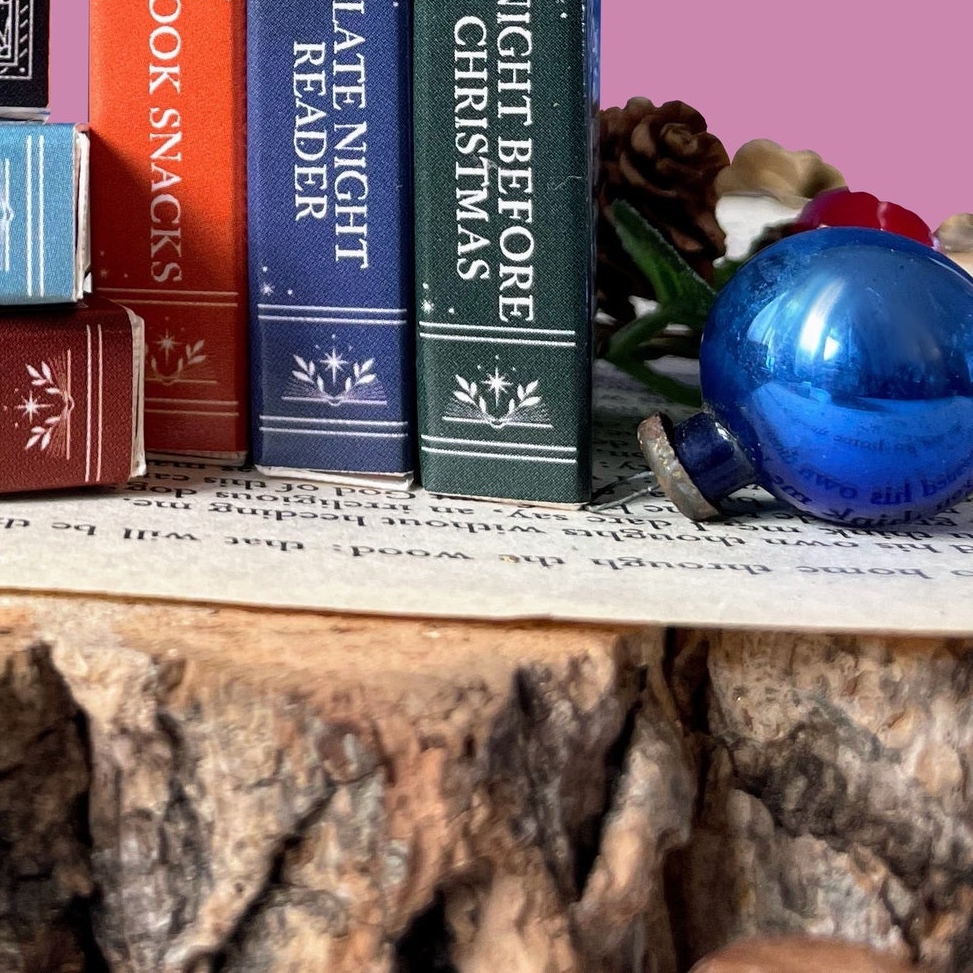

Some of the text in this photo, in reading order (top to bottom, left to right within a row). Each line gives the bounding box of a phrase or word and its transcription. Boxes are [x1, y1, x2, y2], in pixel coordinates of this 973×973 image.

[292, 41, 328, 221] READER
[331, 0, 369, 269] LATE NIGHT
[453, 15, 490, 280] CHRISTMAS
[149, 106, 184, 283] SNACKS
[497, 135, 535, 323] BEFORE
[203, 476, 268, 490] this
[274, 482, 319, 493] of
[215, 492, 412, 514] irreligious
[428, 505, 475, 515] an
[207, 502, 366, 527] heeding
[50, 523, 97, 536] be
[381, 517, 546, 534] without
[586, 516, 672, 530] dare
[123, 527, 199, 541] will
[561, 528, 746, 547] thoughts
[818, 528, 934, 541] think
[224, 536, 305, 552] that
[762, 538, 859, 548] own
[874, 543, 941, 554] his
[498, 554, 565, 569] the
[589, 556, 771, 575] through
[795, 566, 933, 580] home
